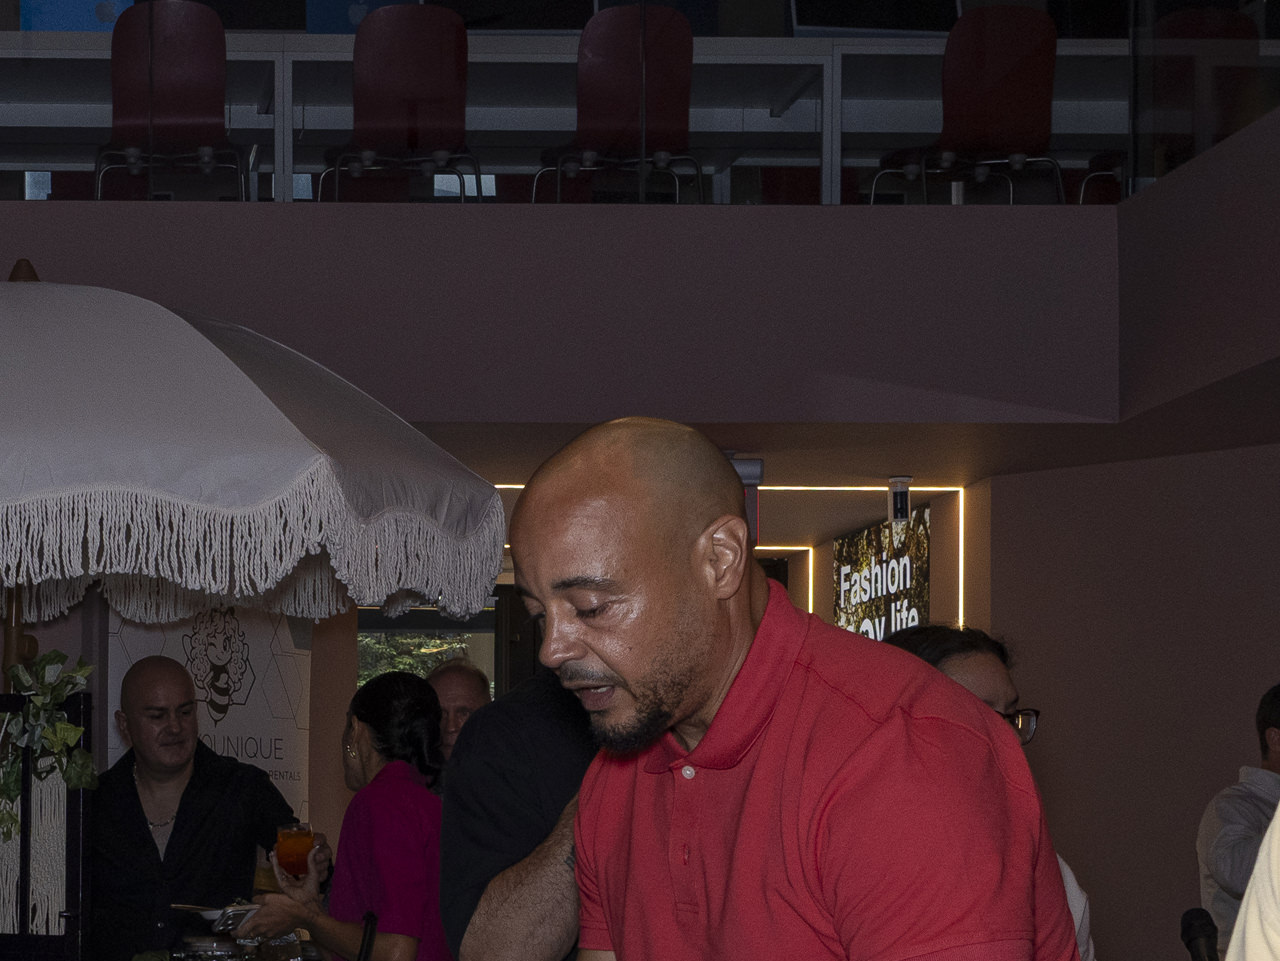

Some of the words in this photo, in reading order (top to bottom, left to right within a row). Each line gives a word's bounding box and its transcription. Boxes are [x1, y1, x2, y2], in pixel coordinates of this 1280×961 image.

[841, 552, 911, 608] Fashion
[891, 599, 919, 633] life
[199, 734, 284, 760] OUNIQUE
[268, 769, 301, 782] RENTALS
